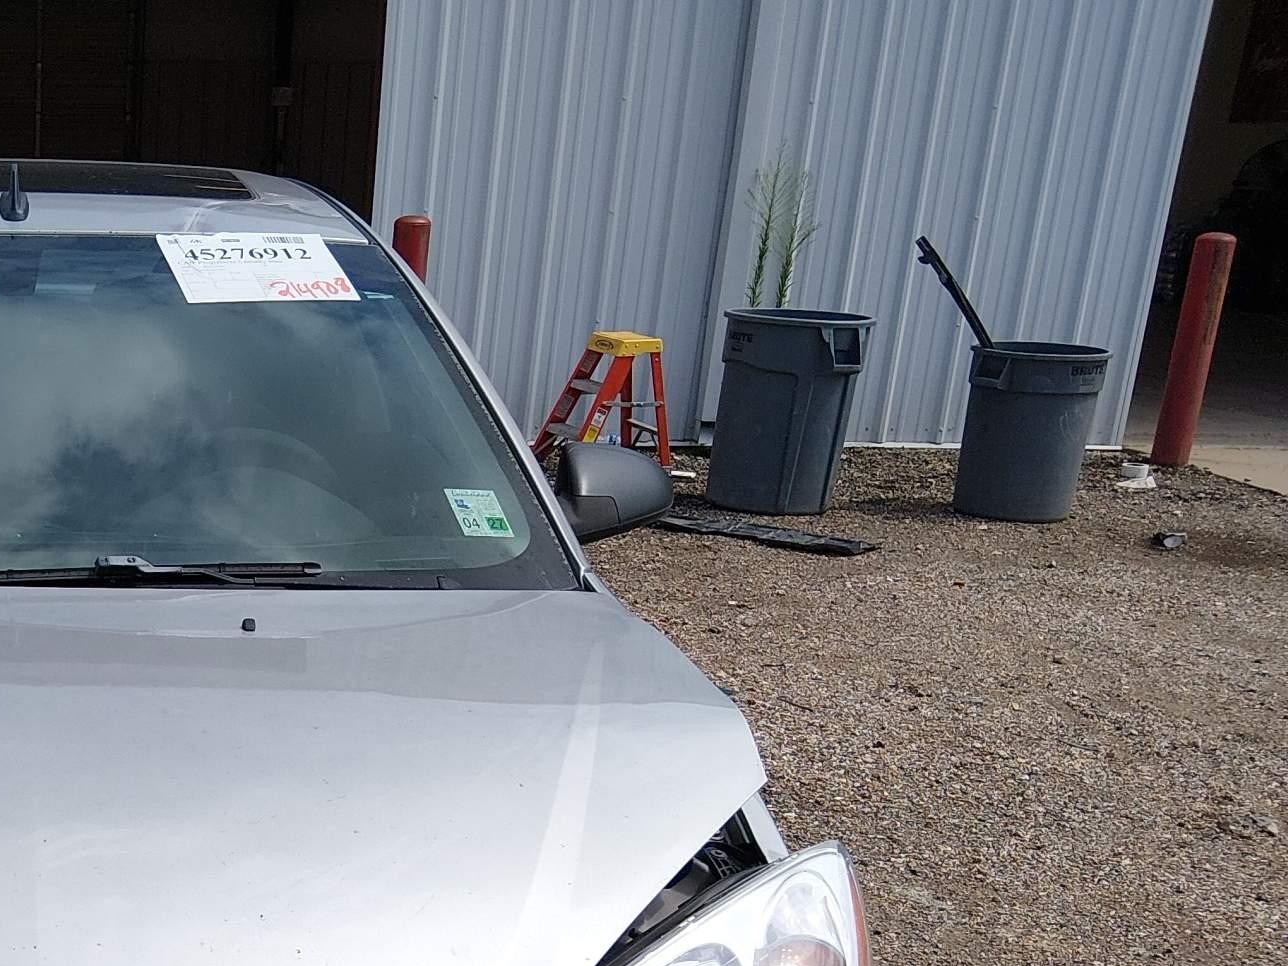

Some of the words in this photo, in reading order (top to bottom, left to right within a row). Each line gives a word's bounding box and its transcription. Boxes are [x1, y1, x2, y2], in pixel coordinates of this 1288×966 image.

[184, 247, 312, 261] 45276912
[462, 517, 481, 529] 04
[489, 517, 507, 530] 27
